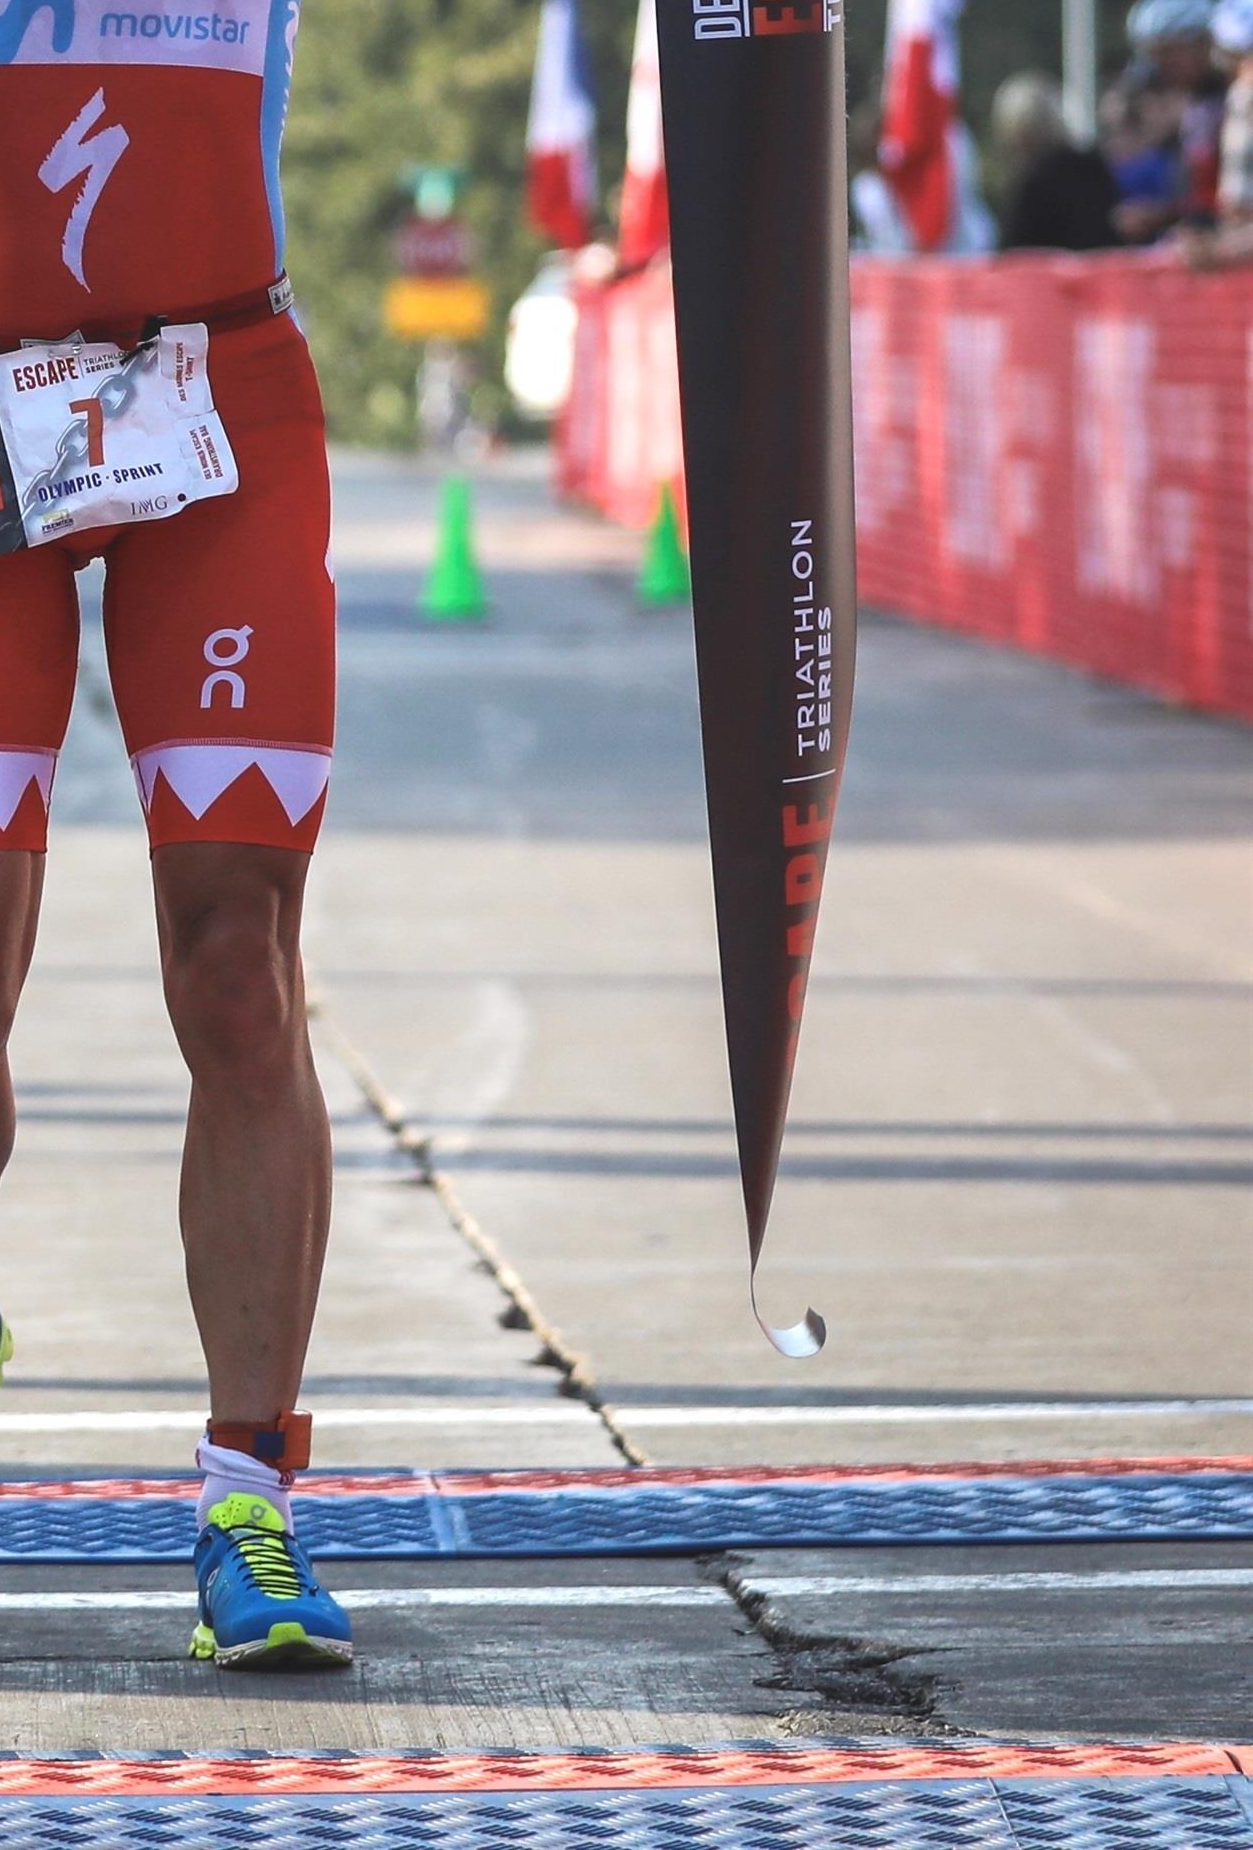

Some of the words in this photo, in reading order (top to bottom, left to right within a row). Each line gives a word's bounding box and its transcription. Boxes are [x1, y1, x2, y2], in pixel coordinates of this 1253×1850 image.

[99, 12, 250, 44] movistar
[12, 357, 79, 393] ESCAPE
[86, 362, 115, 374] SERIES
[68, 397, 106, 467] 7
[38, 472, 103, 503] OLYMPIC
[112, 463, 164, 484] SPRINT
[790, 518, 816, 757] TRIATHLON
[816, 606, 833, 753] SERIES
